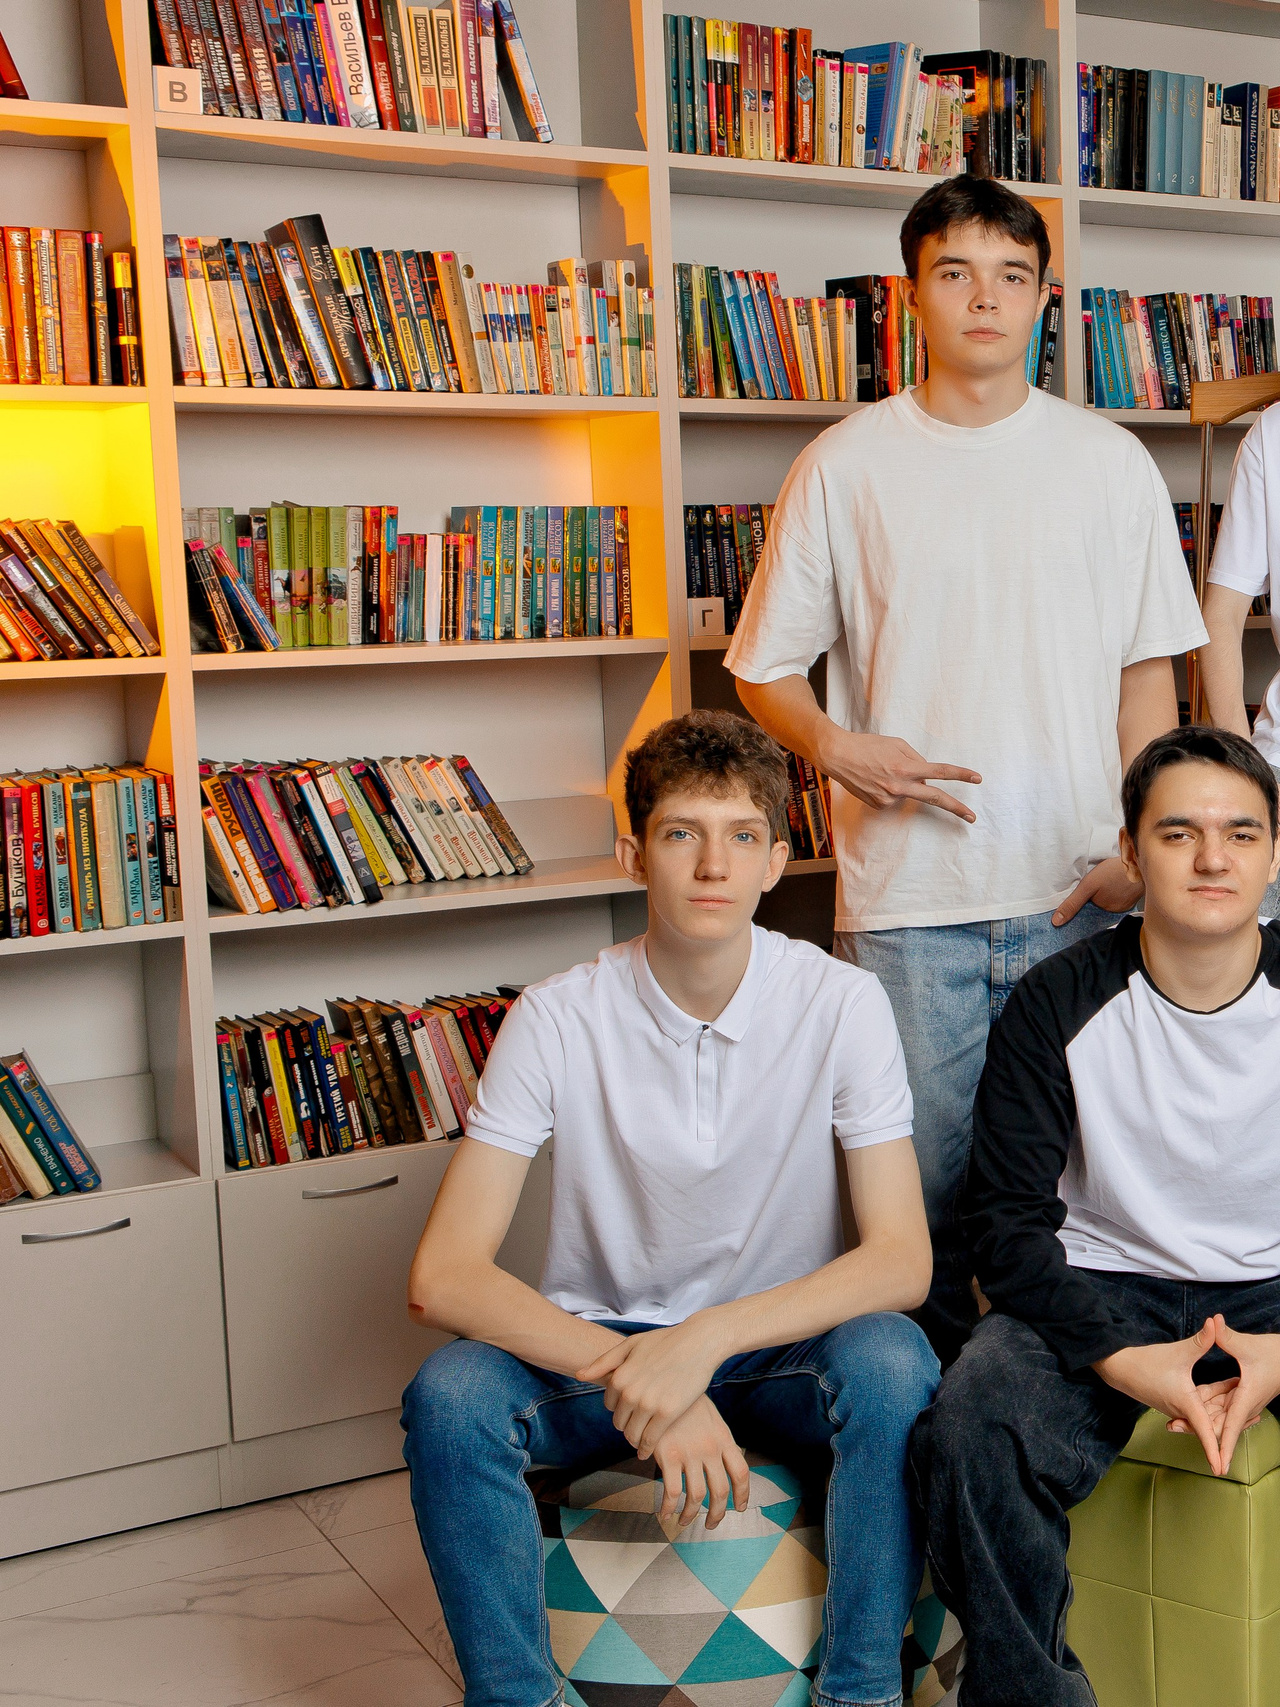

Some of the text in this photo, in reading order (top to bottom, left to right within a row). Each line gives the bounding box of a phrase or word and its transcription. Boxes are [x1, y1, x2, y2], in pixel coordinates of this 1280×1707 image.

[337, 11, 363, 95] Васильев
[416, 18, 429, 57] ВАСИЛЬЕВ
[439, 20, 450, 58] ВАСИЛЬЕВ
[378, 62, 393, 110] ОФИЦЕРЫ
[466, 21, 479, 114] БОРИС ВАСИЛЬЕВ
[168, 81, 188, 103] В
[284, 80, 296, 110] КОГОРТА
[322, 244, 338, 279] КРЕМЛЯ
[383, 255, 403, 299] ВАСИНА
[405, 257, 421, 302] ВАСИНА
[325, 294, 350, 358] КРЕМЛЕВСКИЕ
[386, 333, 404, 384] НИНА ВАСИНА
[1159, 319, 1178, 386] ЦИКЛОГЕКСАН
[487, 522, 495, 557] ВЕРЕСОВ
[622, 568, 630, 613] ВЕРЕСОВ
[723, 538, 734, 601] АКАДЕМИЯ СТИХИЙ
[350, 576, 359, 635] ВЕРБИНИНА
[702, 610, 713, 627] Г
[31, 792, 39, 828] БУШКОВ
[141, 784, 150, 820] АЛЕКСАНДР
[395, 799, 415, 833] ЕКАТЕРИНА
[79, 808, 95, 910] РЫЦАРЬ ИЗ НИОТКУДА
[210, 781, 271, 904] ВЕРНЫЙ РУСЛАН
[11, 838, 25, 898] БУШКОВ
[392, 1019, 411, 1056] МЕДВЕДЬ
[325, 1063, 346, 1123] ТРЕТИЙ УДАР
[409, 1070, 436, 1130] ВЛАДИМИР ВЛАСОВ
